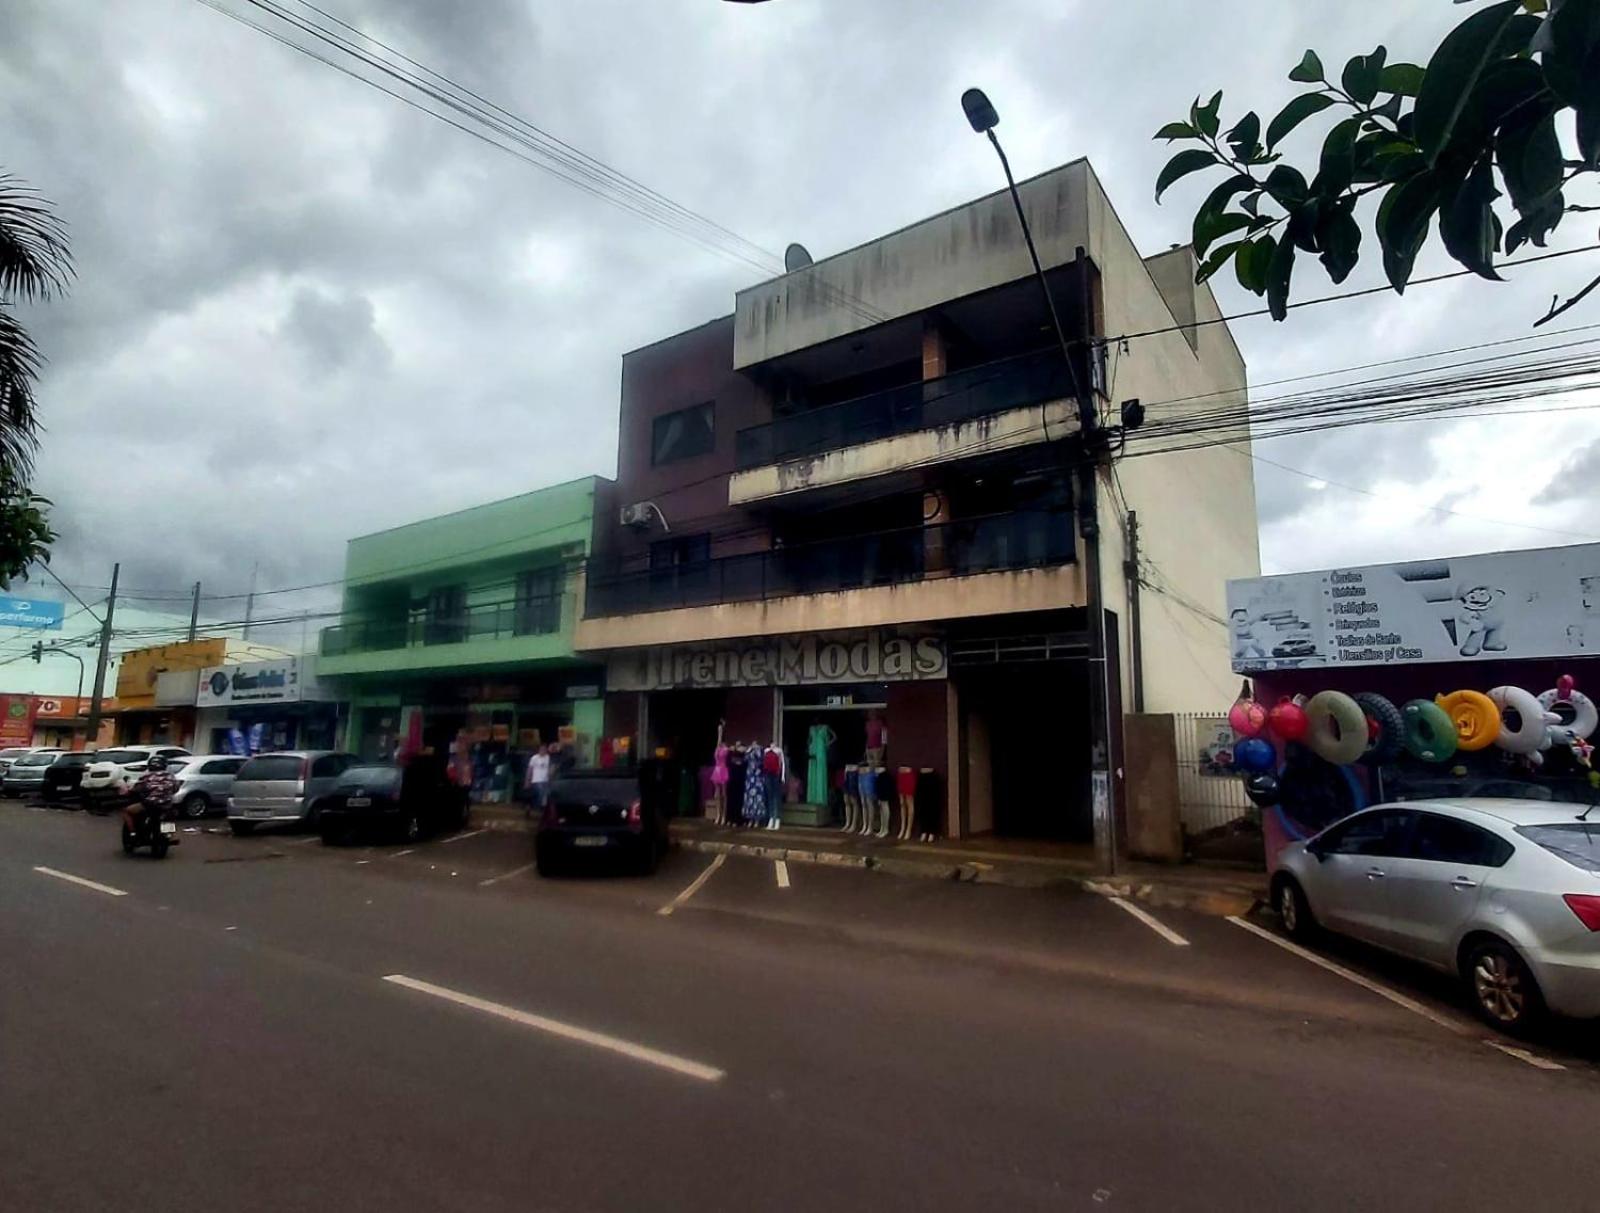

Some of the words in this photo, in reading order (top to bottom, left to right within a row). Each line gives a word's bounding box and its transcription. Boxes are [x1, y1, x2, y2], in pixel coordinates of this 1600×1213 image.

[1333, 601, 1378, 616] Relógios
[777, 630, 944, 682] Modas
[1395, 646, 1423, 659] Casa
